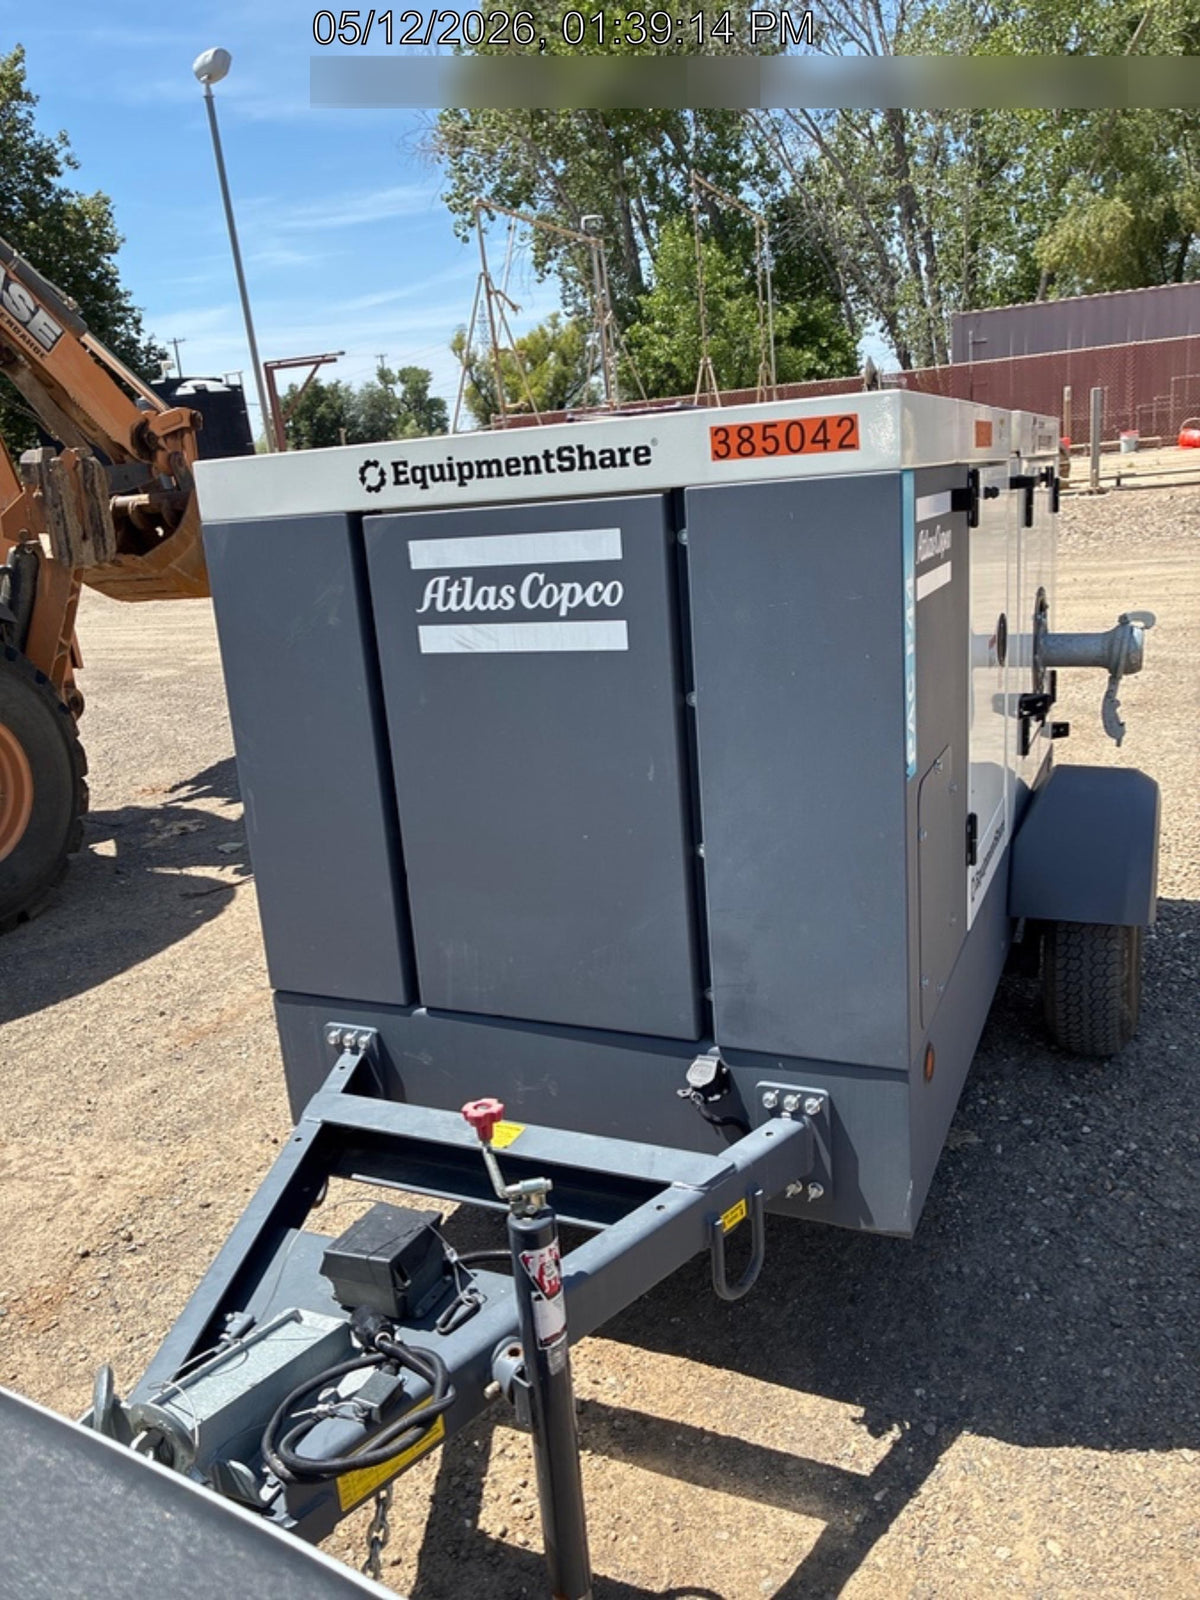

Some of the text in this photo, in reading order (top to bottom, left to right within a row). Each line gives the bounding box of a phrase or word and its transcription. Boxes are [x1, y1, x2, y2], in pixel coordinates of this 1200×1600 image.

[713, 416, 856, 459] 385042
[390, 444, 652, 490] EquipmentShare
[415, 571, 624, 617] Atlas Copco
